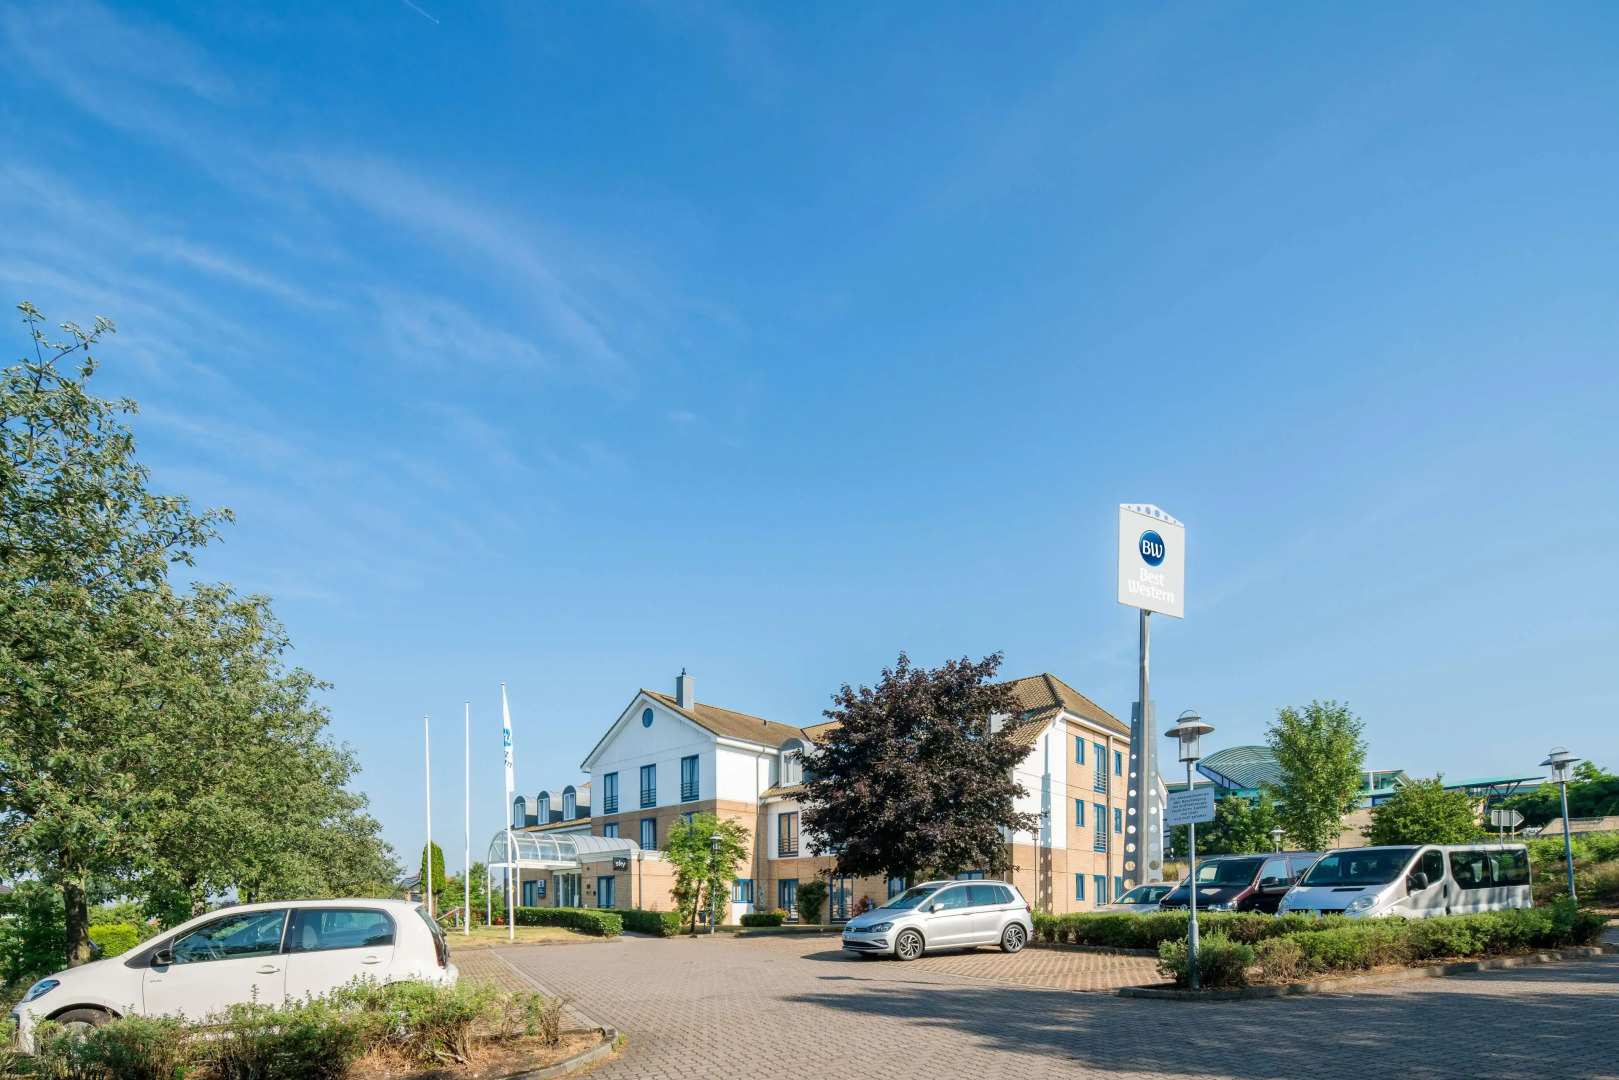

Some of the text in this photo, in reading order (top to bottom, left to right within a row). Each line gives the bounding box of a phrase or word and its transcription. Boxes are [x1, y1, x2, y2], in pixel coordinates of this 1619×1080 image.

[1142, 540, 1162, 558] BW
[1140, 567, 1164, 586] Best
[1128, 578, 1174, 604] Western
[615, 860, 626, 868] sky
